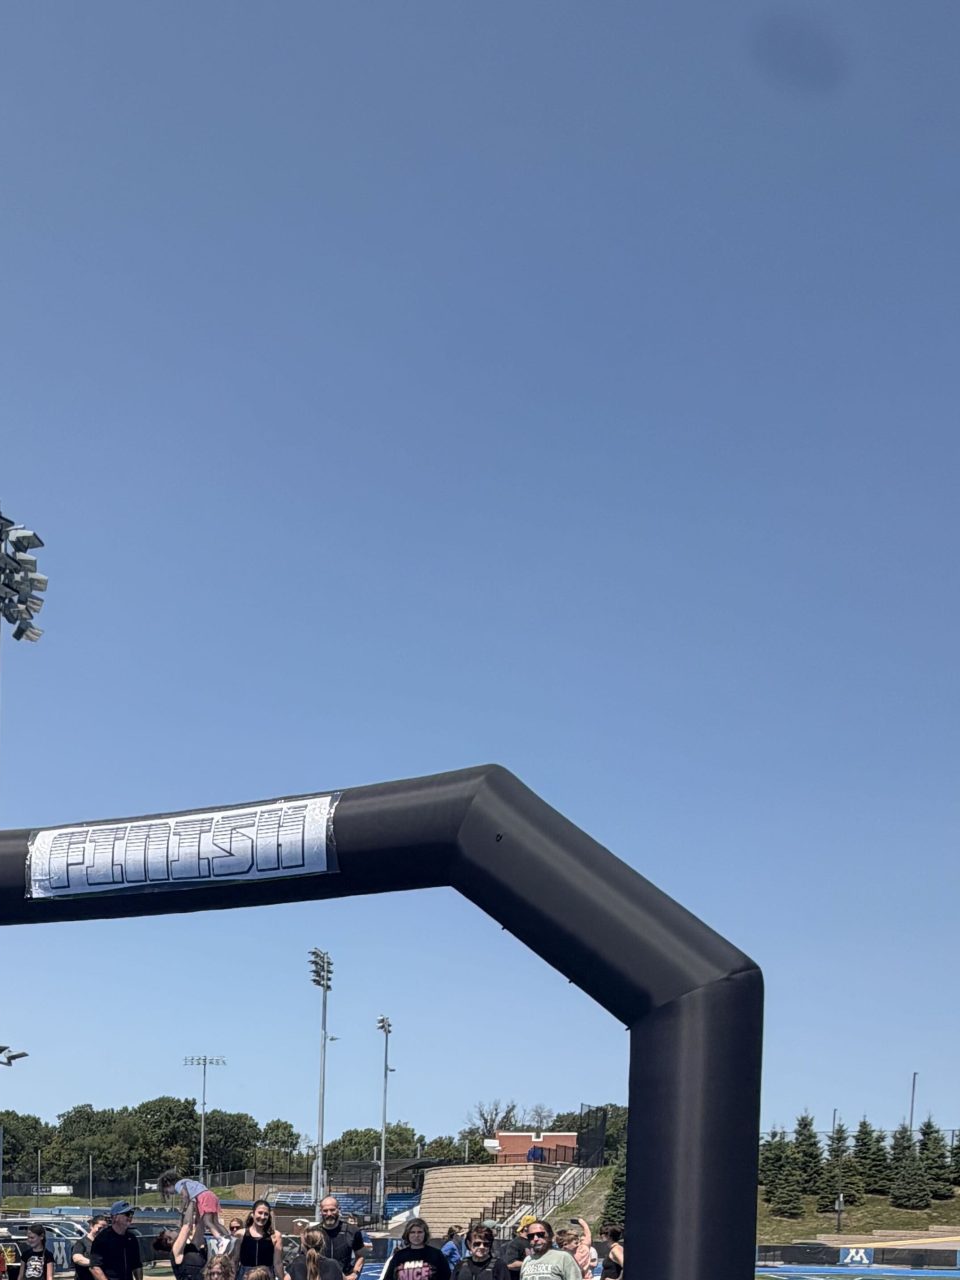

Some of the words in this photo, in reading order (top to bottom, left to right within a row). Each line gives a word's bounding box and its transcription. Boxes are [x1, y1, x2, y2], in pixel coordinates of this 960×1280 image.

[48, 804, 308, 889] FINISH
[843, 1249, 869, 1263] M
[403, 1260, 424, 1269] MN
